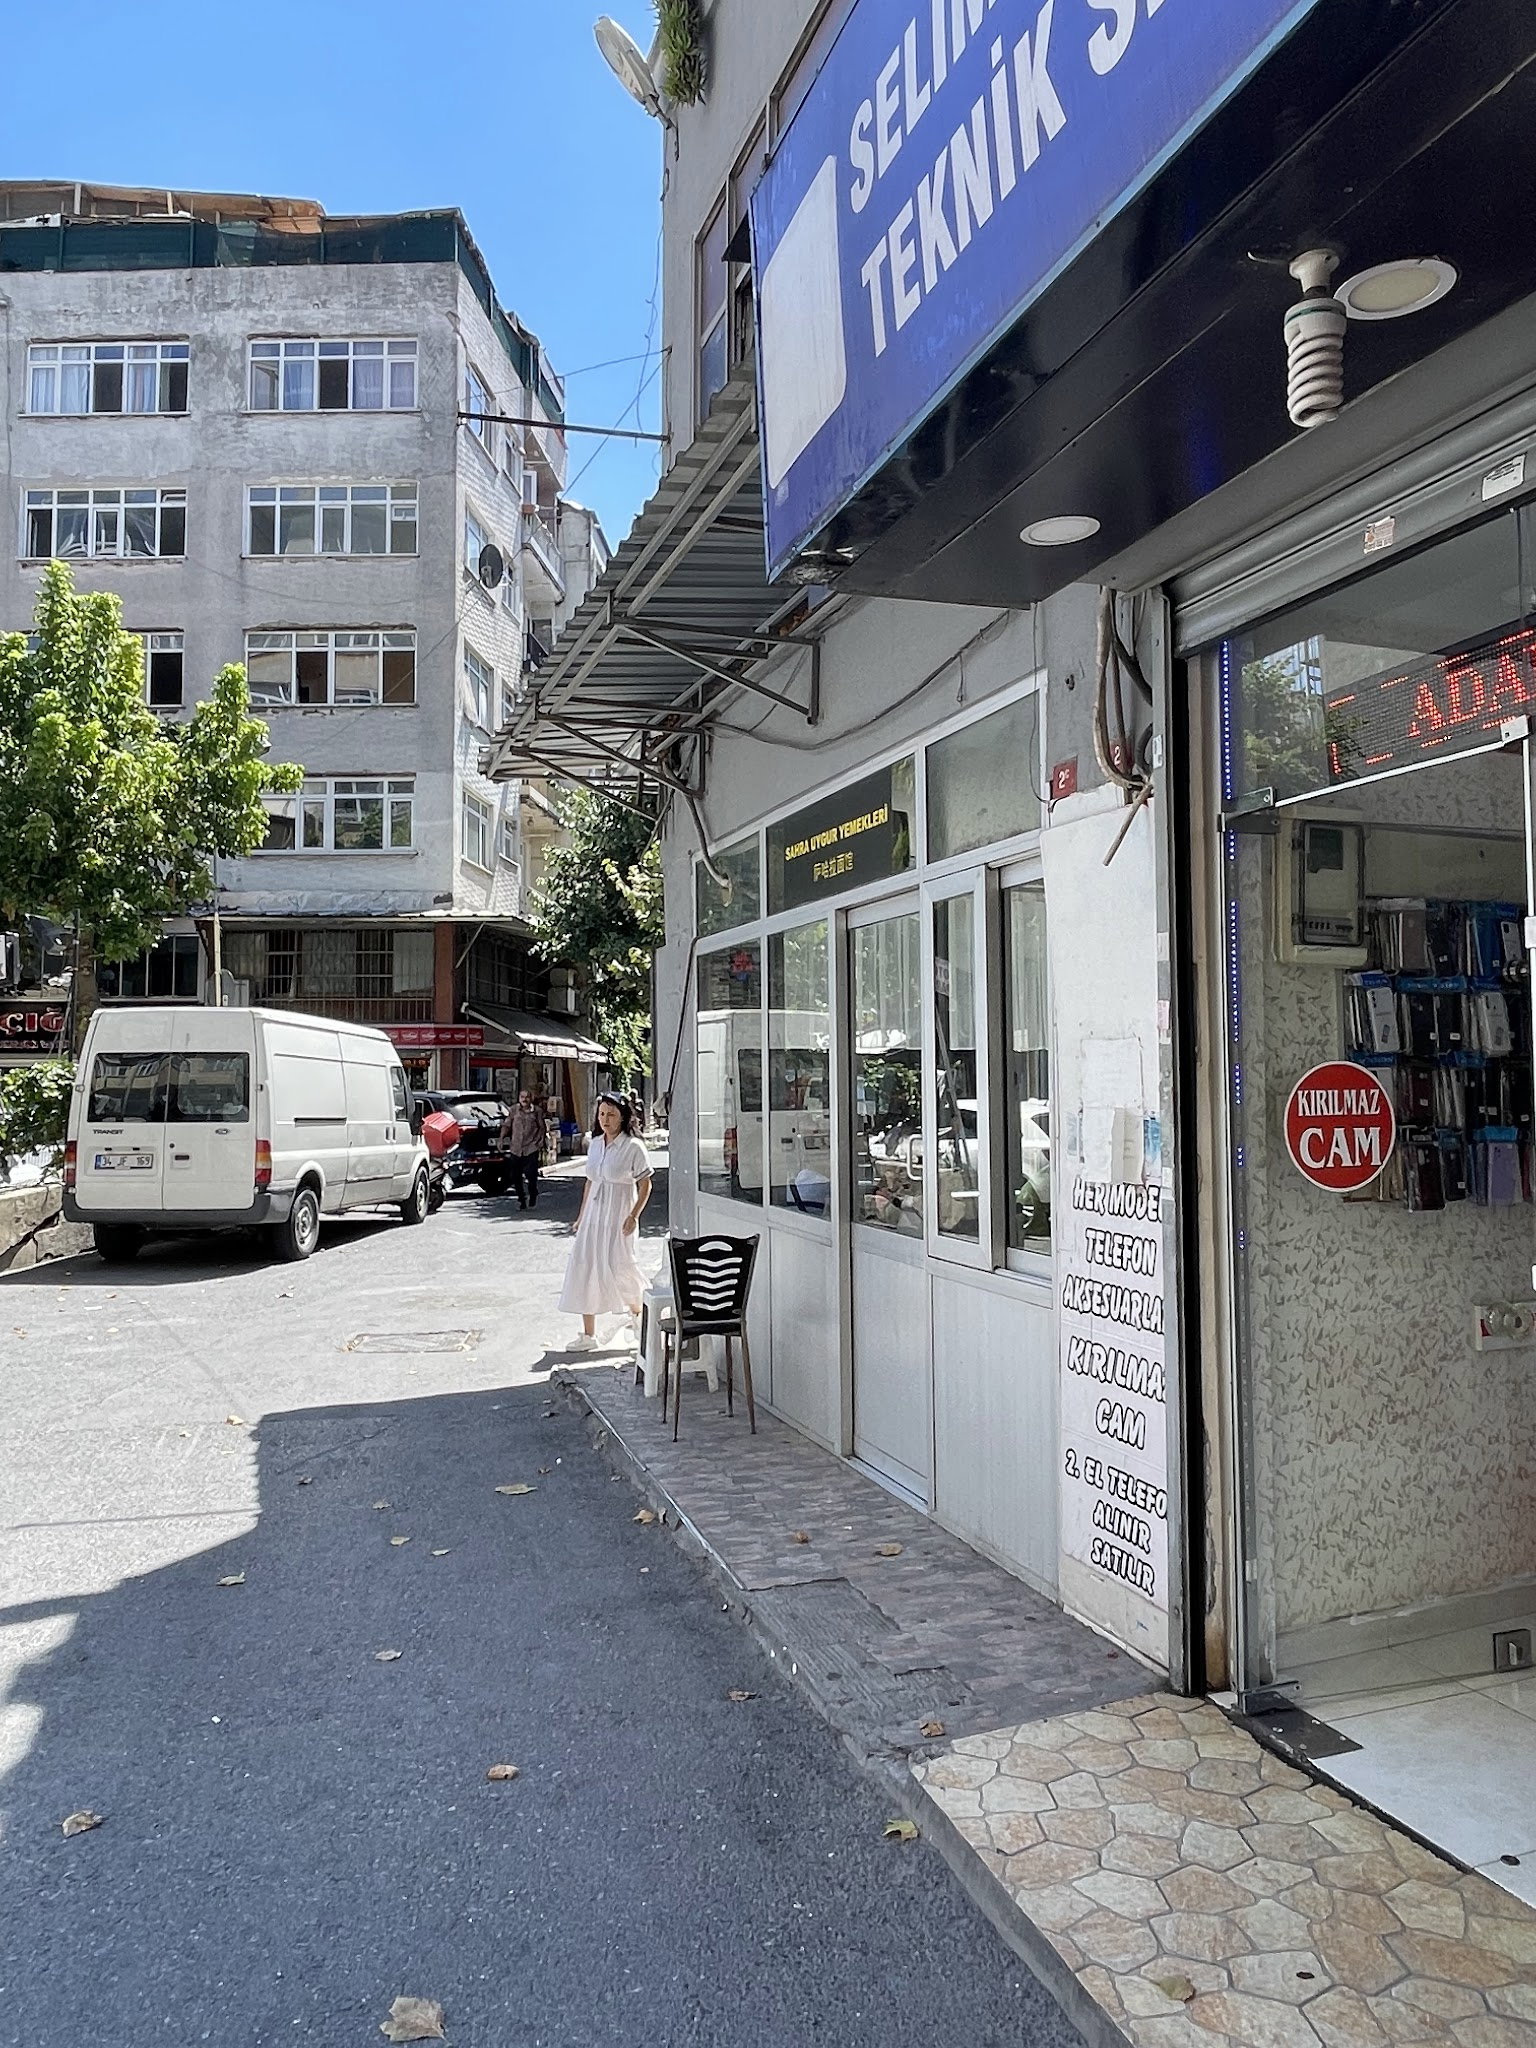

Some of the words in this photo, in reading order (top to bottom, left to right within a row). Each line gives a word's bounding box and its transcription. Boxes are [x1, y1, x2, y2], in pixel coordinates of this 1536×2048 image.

[861, 0, 1067, 358] TEKNİK
[784, 840, 810, 861] SAHRA
[810, 827, 838, 851] UYGUR
[838, 803, 889, 840] YEMEKLERİ
[1297, 1089, 1380, 1116] KIRILMAZ
[1300, 1127, 1381, 1169] CAM
[1073, 1175, 1105, 1216] HER
[1085, 1227, 1157, 1277] TELEFON
[1062, 1273, 1164, 1335] AKSESUARLA
[1067, 1335, 1166, 1404] KIRILMA
[1096, 1398, 1146, 1450] CAM
[1065, 1448, 1080, 1479] 2.
[1084, 1456, 1104, 1490] EL
[1093, 1499, 1151, 1555] ALINIR
[1091, 1537, 1155, 1597] SATILIR
